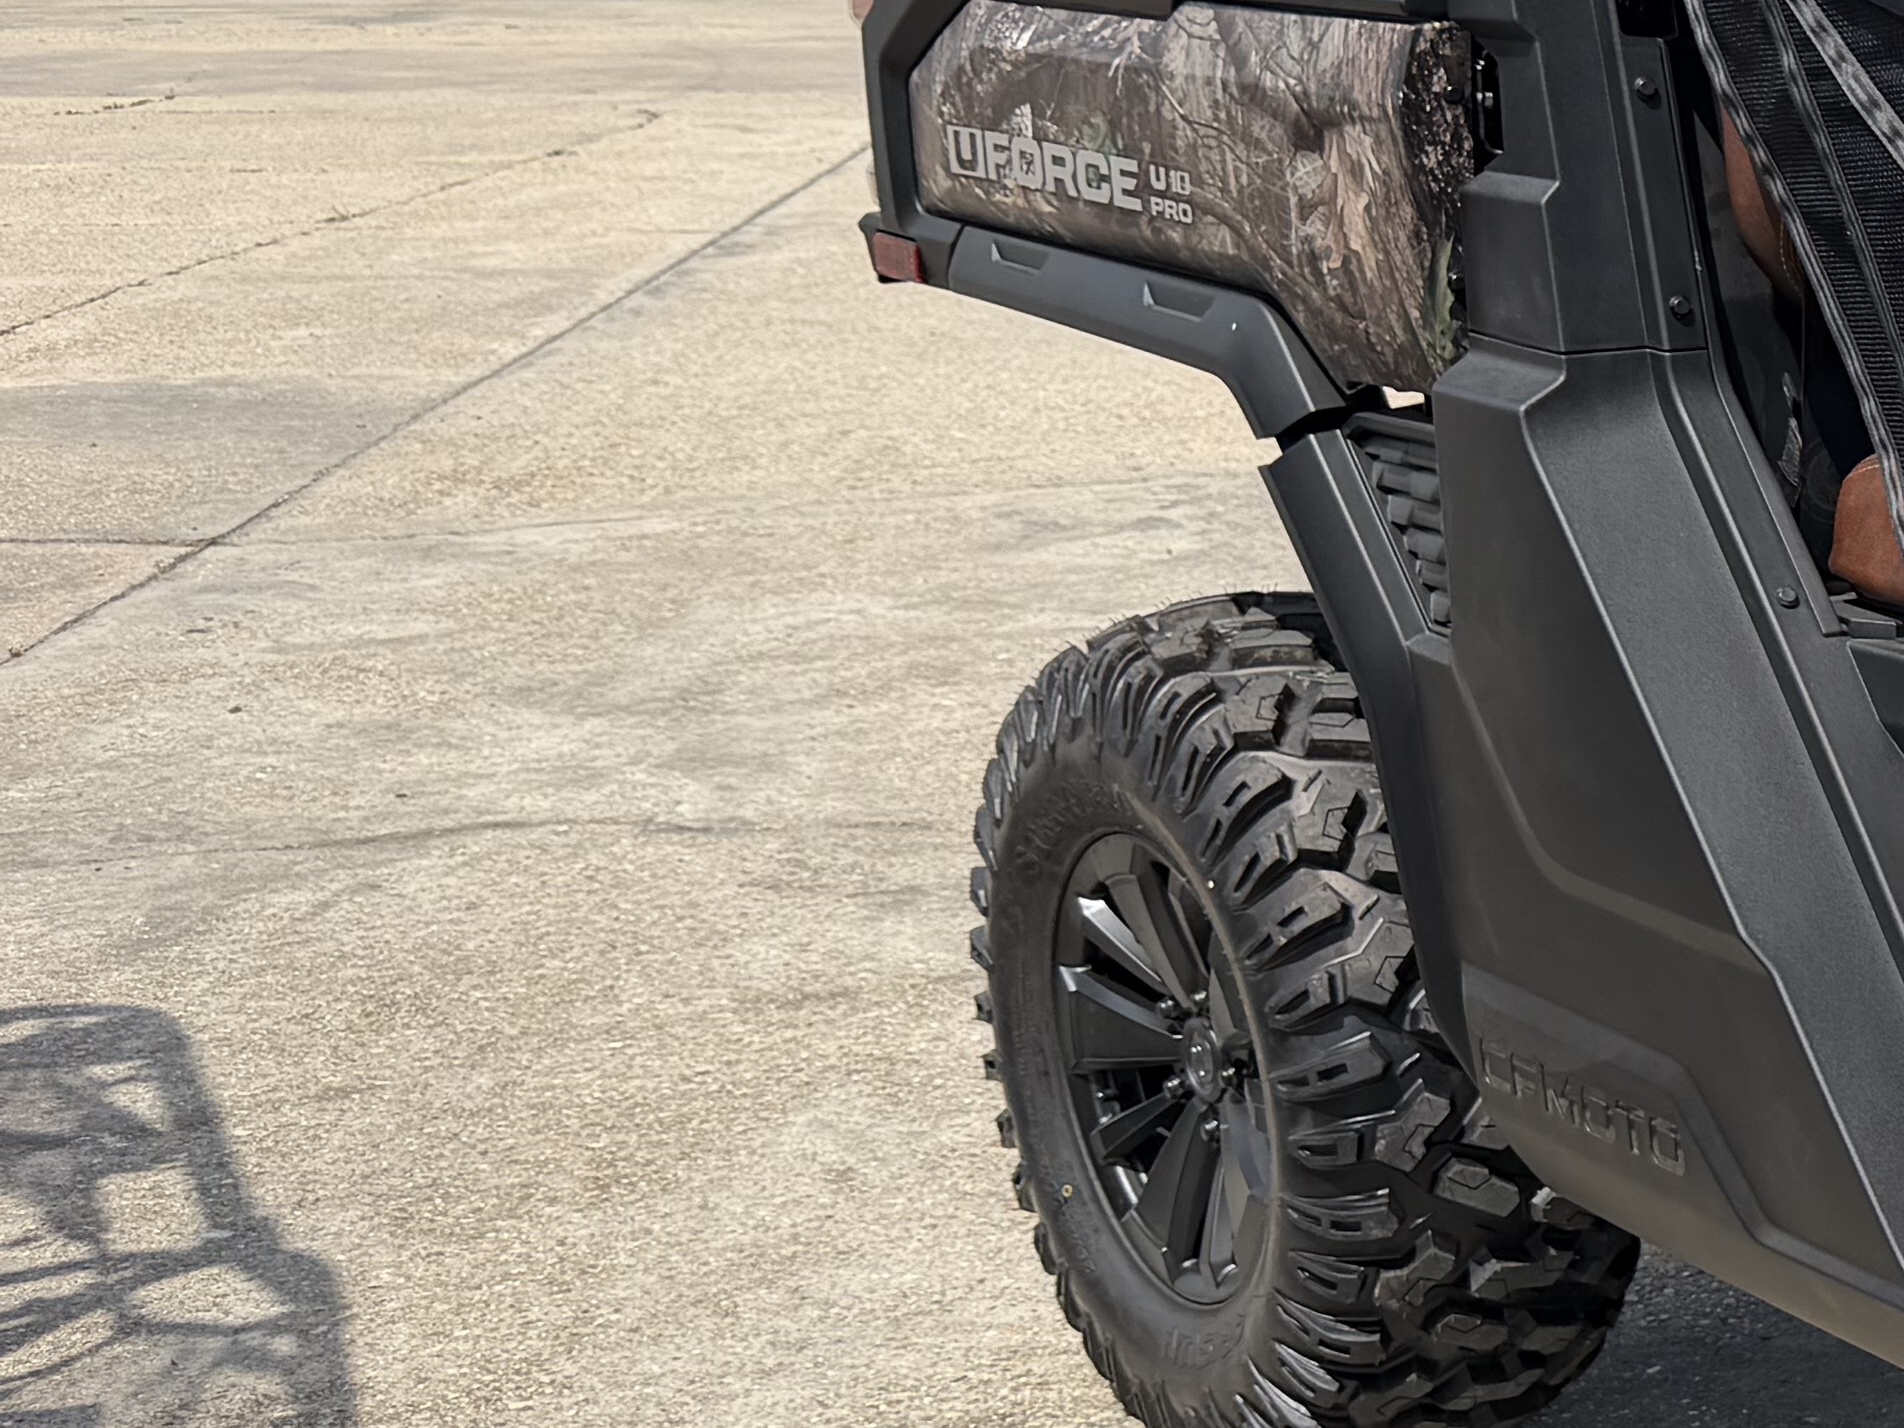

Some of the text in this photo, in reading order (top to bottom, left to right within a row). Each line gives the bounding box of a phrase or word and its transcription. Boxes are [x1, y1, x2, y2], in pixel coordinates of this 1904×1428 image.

[946, 124, 1144, 212] UFORCE
[1150, 196, 1193, 224] PRO
[1479, 1037, 1686, 1176] CFMOTO
